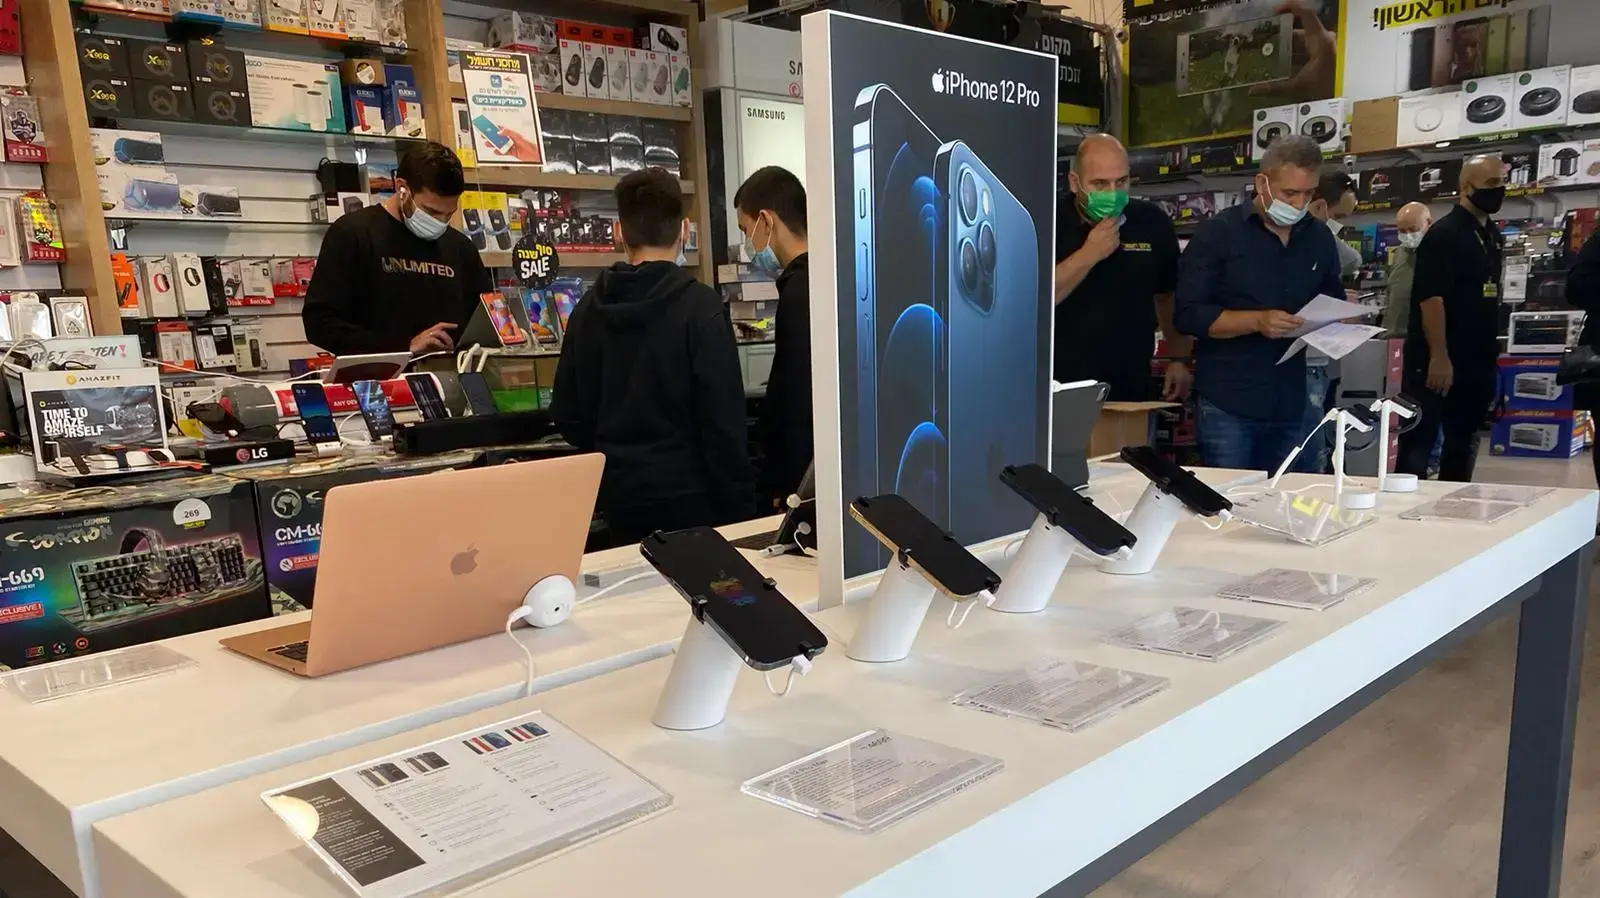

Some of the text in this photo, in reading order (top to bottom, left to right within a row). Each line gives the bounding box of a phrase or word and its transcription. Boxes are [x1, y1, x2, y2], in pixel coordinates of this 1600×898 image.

[1041, 34, 1071, 56] מקום
[789, 60, 804, 75] SA
[945, 70, 1040, 108] iPhone 12 Pro
[747, 107, 786, 120] SAMSUNG
[518, 249, 539, 260] שנה
[535, 243, 552, 256] סוף
[381, 256, 455, 278] UNLIMITED
[521, 256, 550, 279] SALE
[41, 407, 88, 420] TIME TO
[44, 417, 86, 429] AMAZE
[252, 447, 268, 459] LG
[184, 509, 200, 519] 269
[274, 522, 322, 541] CM-66
[0, 566, 45, 588] -669
[0, 603, 42, 616] XCLUSIVE!
